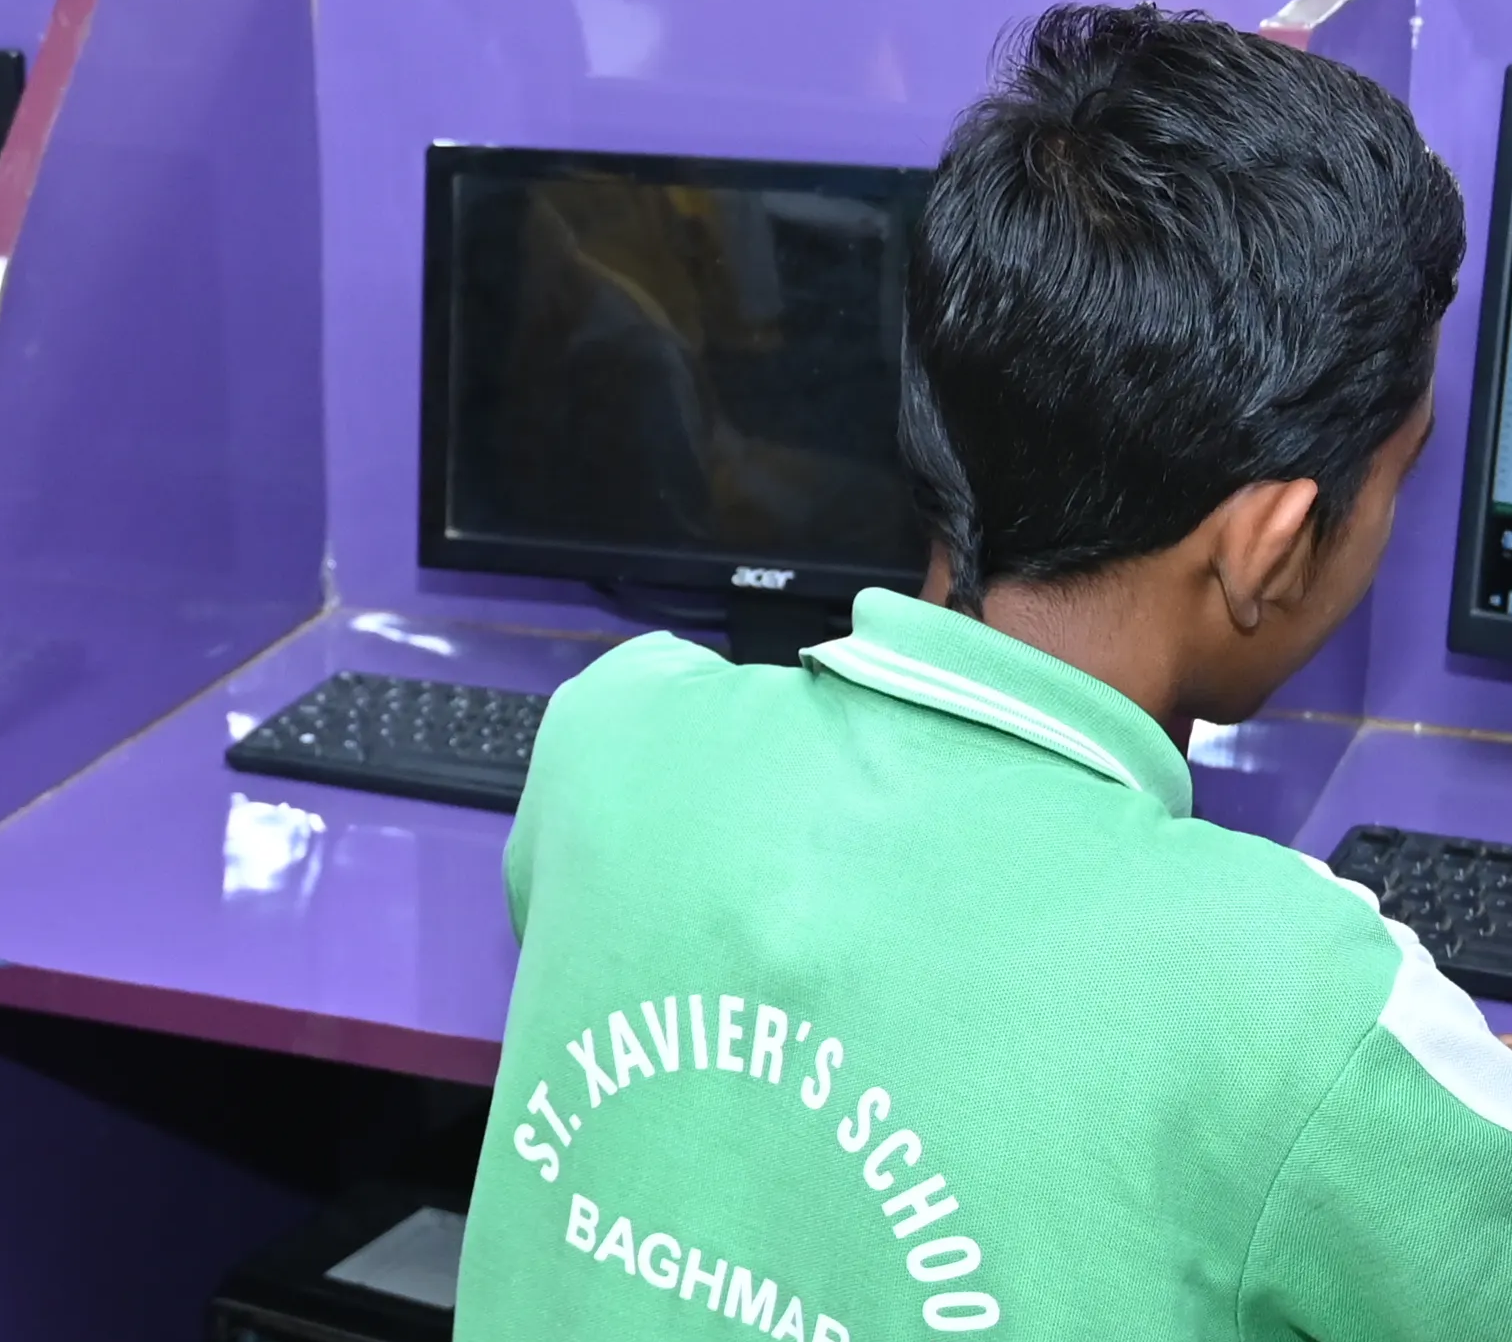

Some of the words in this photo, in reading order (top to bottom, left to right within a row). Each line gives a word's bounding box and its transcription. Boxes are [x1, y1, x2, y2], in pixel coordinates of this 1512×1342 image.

[730, 564, 796, 591] acer
[513, 1080, 583, 1184] ST.
[564, 993, 845, 1111] XAVIER'S
